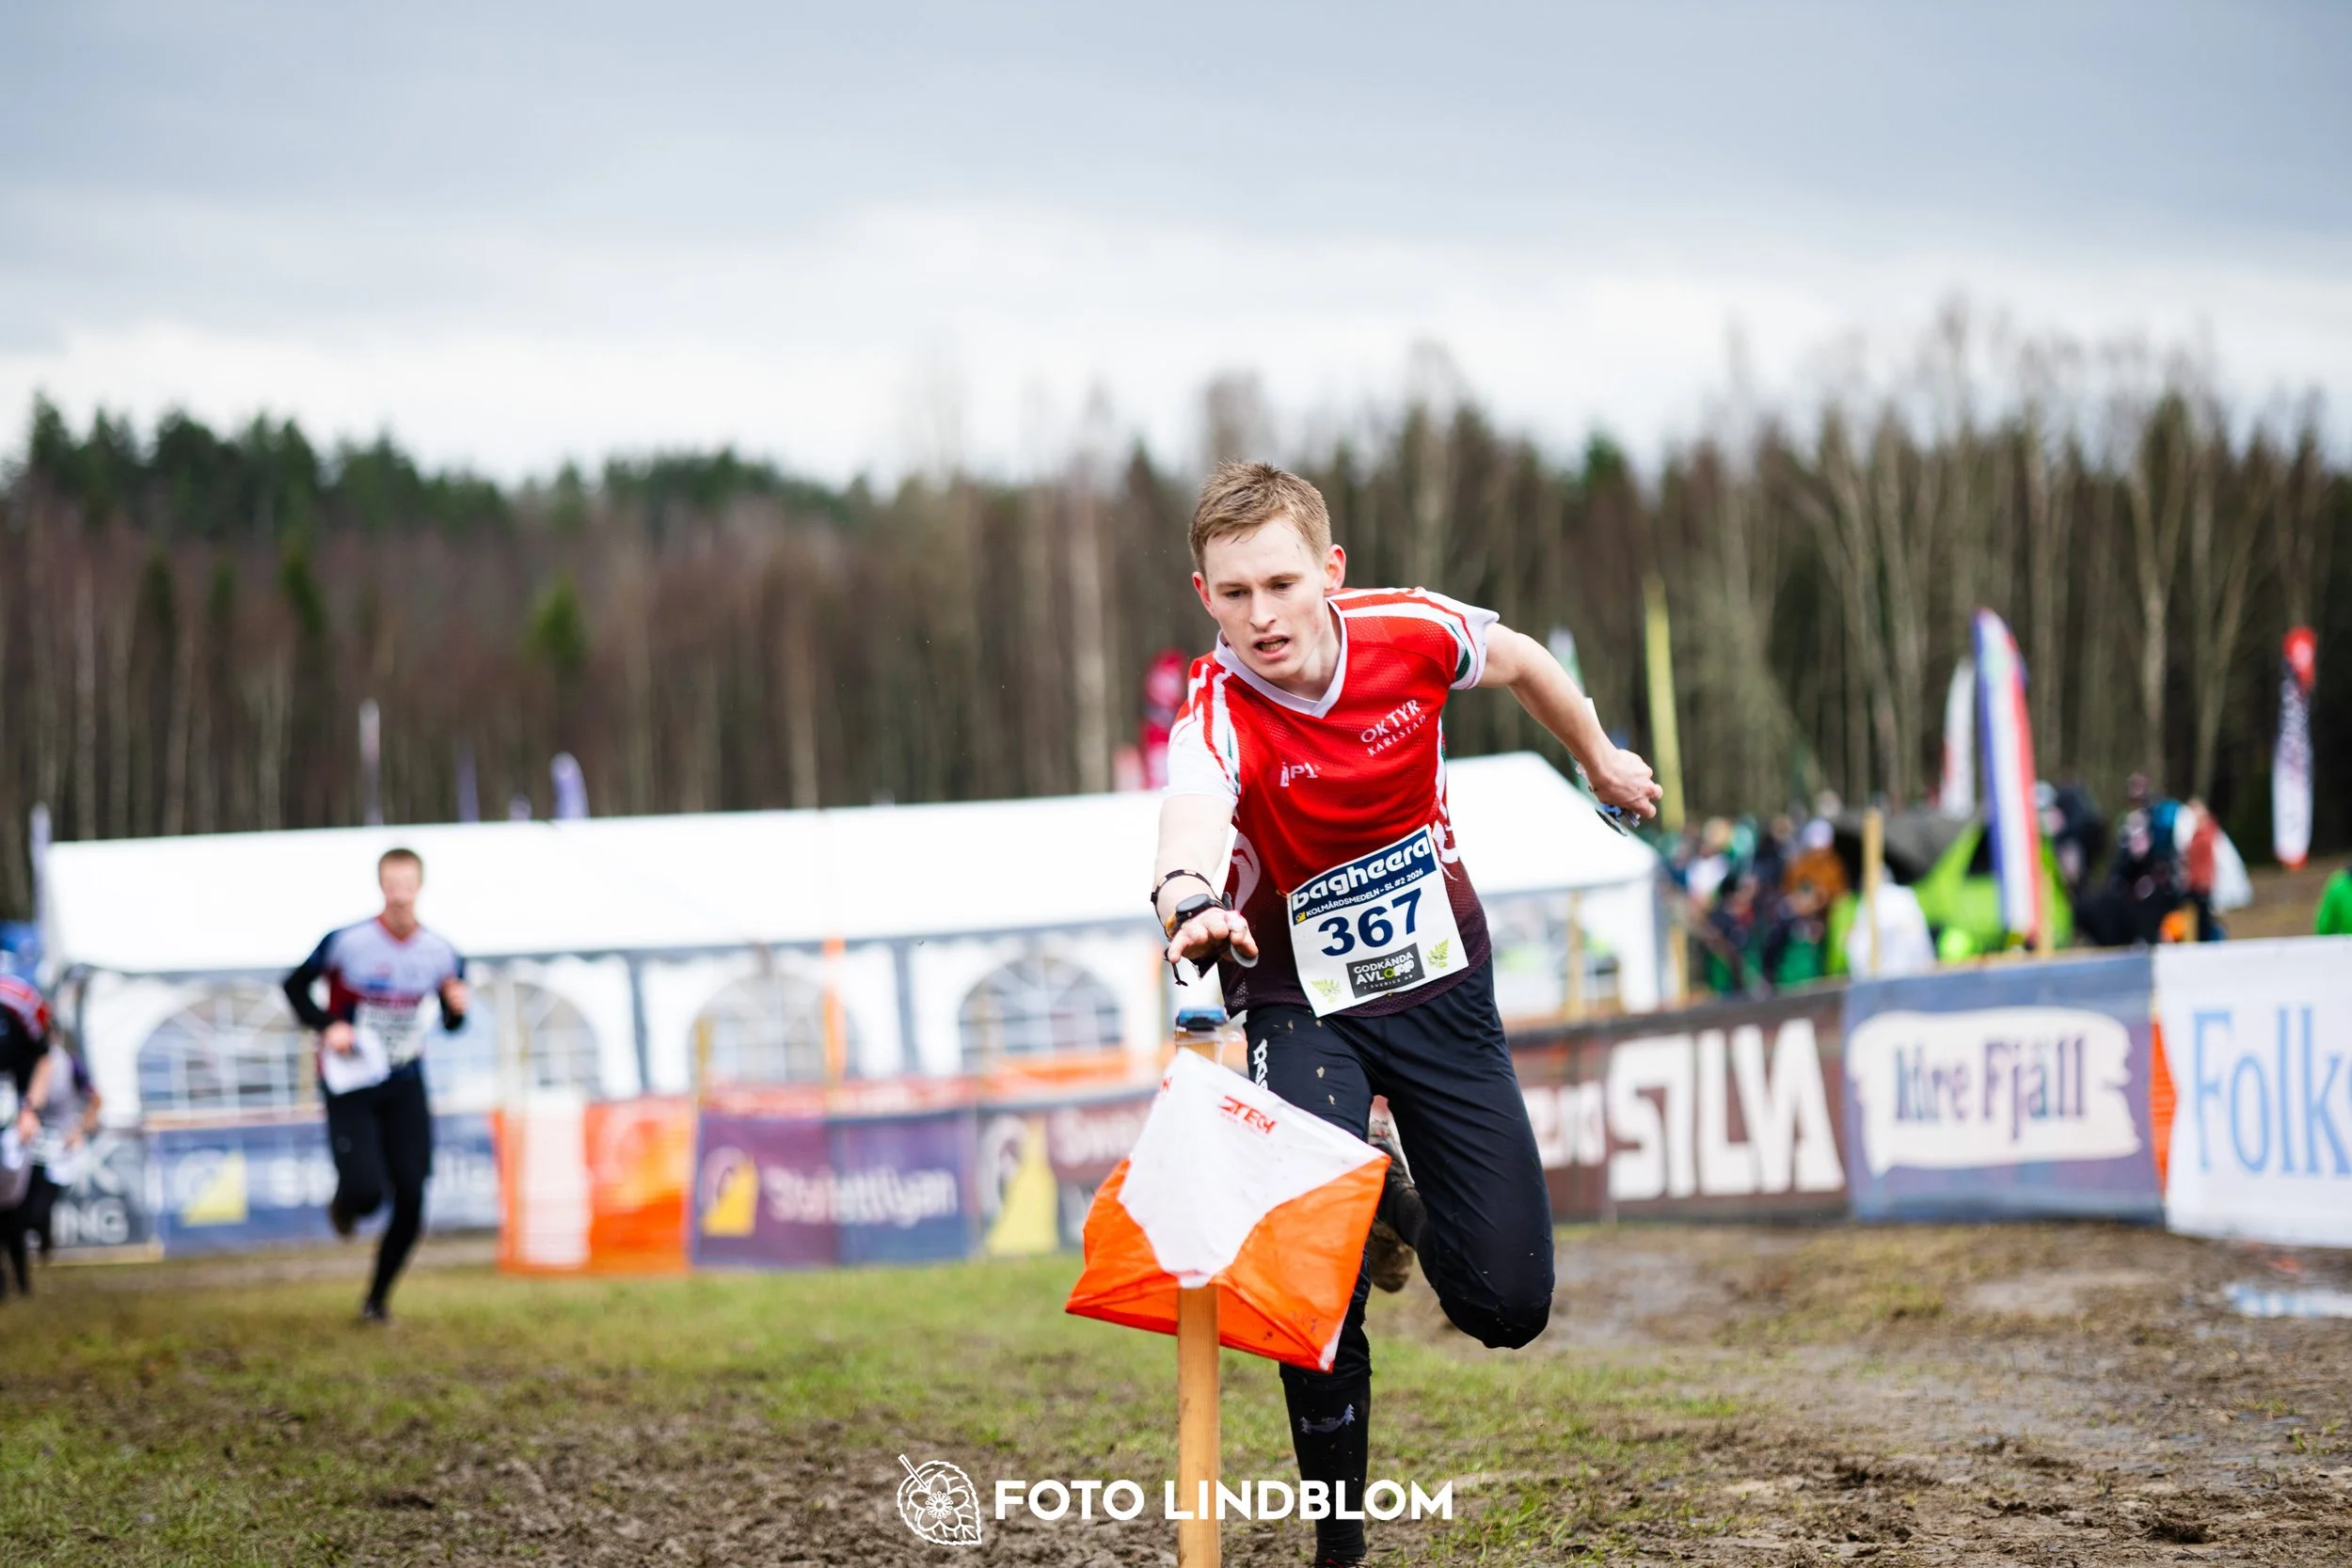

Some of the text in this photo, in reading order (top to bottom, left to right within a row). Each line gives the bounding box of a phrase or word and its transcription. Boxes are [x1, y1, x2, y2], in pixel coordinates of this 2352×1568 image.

[1360, 700, 1421, 742] OK TYR
[1367, 715, 1426, 756] KARLSTAD
[1292, 835, 1430, 911] bagheera
[1306, 890, 1380, 917] KOLMÅRDSMEDELN
[1385, 881, 1394, 892] SL
[1394, 877, 1406, 888] #2
[1406, 868, 1423, 881] 2026
[1318, 887, 1422, 957] 367
[1354, 952, 1414, 974] GODKÄNDA
[1608, 1019, 1845, 1200] SILVA
[1983, 1034, 2085, 1141] Fjäll
